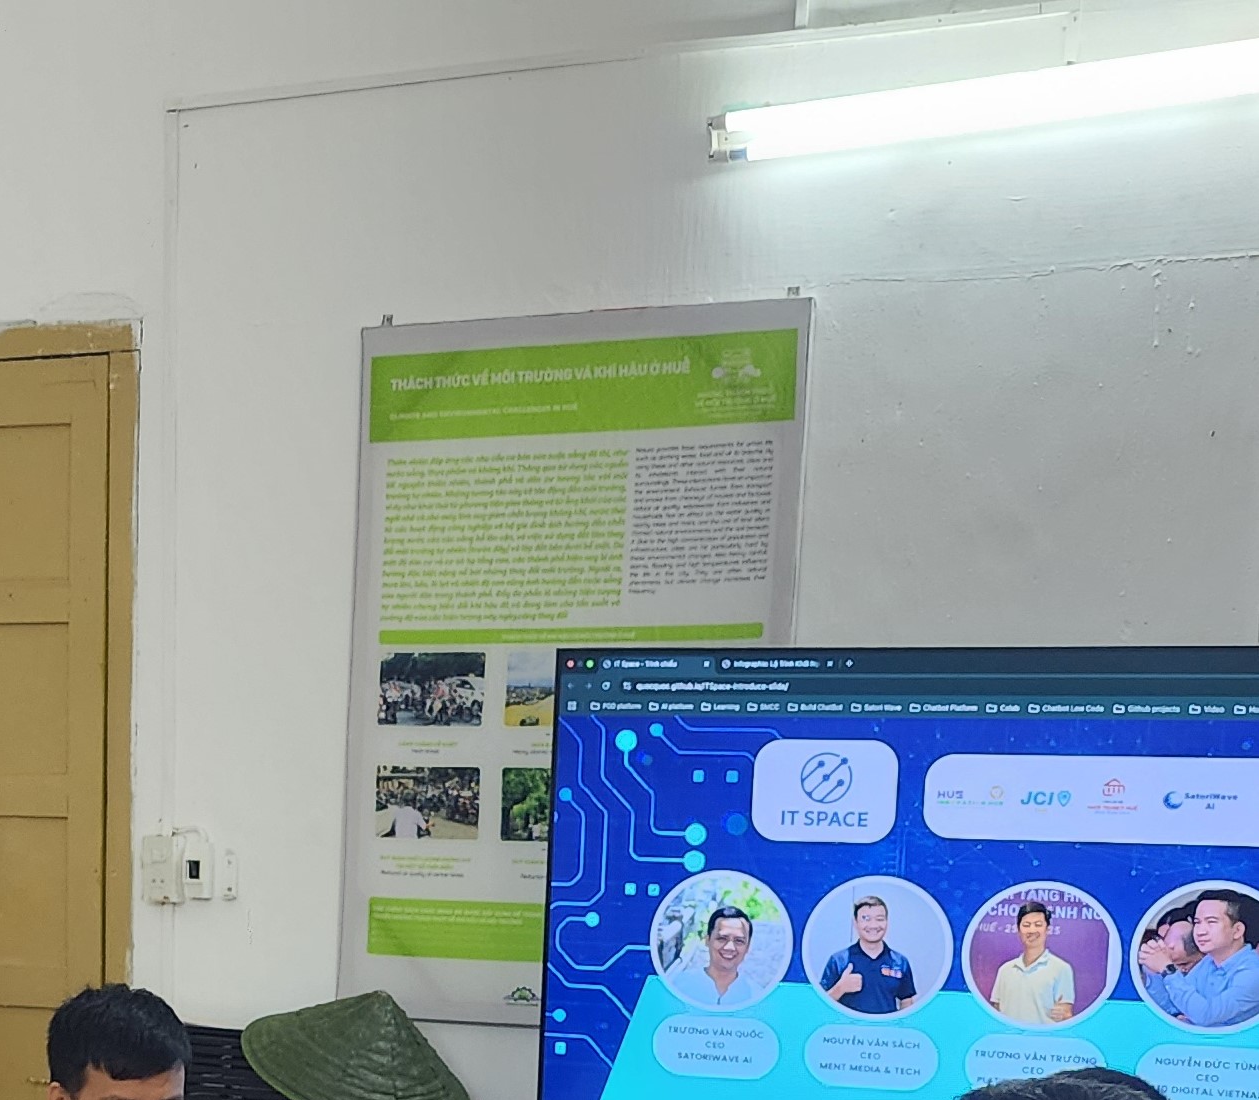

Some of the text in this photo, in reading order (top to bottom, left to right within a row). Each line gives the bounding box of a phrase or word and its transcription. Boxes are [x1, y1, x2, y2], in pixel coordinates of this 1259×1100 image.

[1020, 791, 1054, 806] JCI
[780, 811, 868, 828] IT SPACE
[705, 1041, 725, 1049] CEO
[678, 1052, 752, 1064] SATORIWAVE AI
[860, 1052, 881, 1060] CEO
[820, 1062, 920, 1076] MENT MEDIA & TECH
[1022, 1066, 1044, 1074] CEO
[1196, 1074, 1220, 1082] CEO
[1172, 1086, 1214, 1096] DIGITAL
[1217, 1088, 1259, 1100] VIETNA
